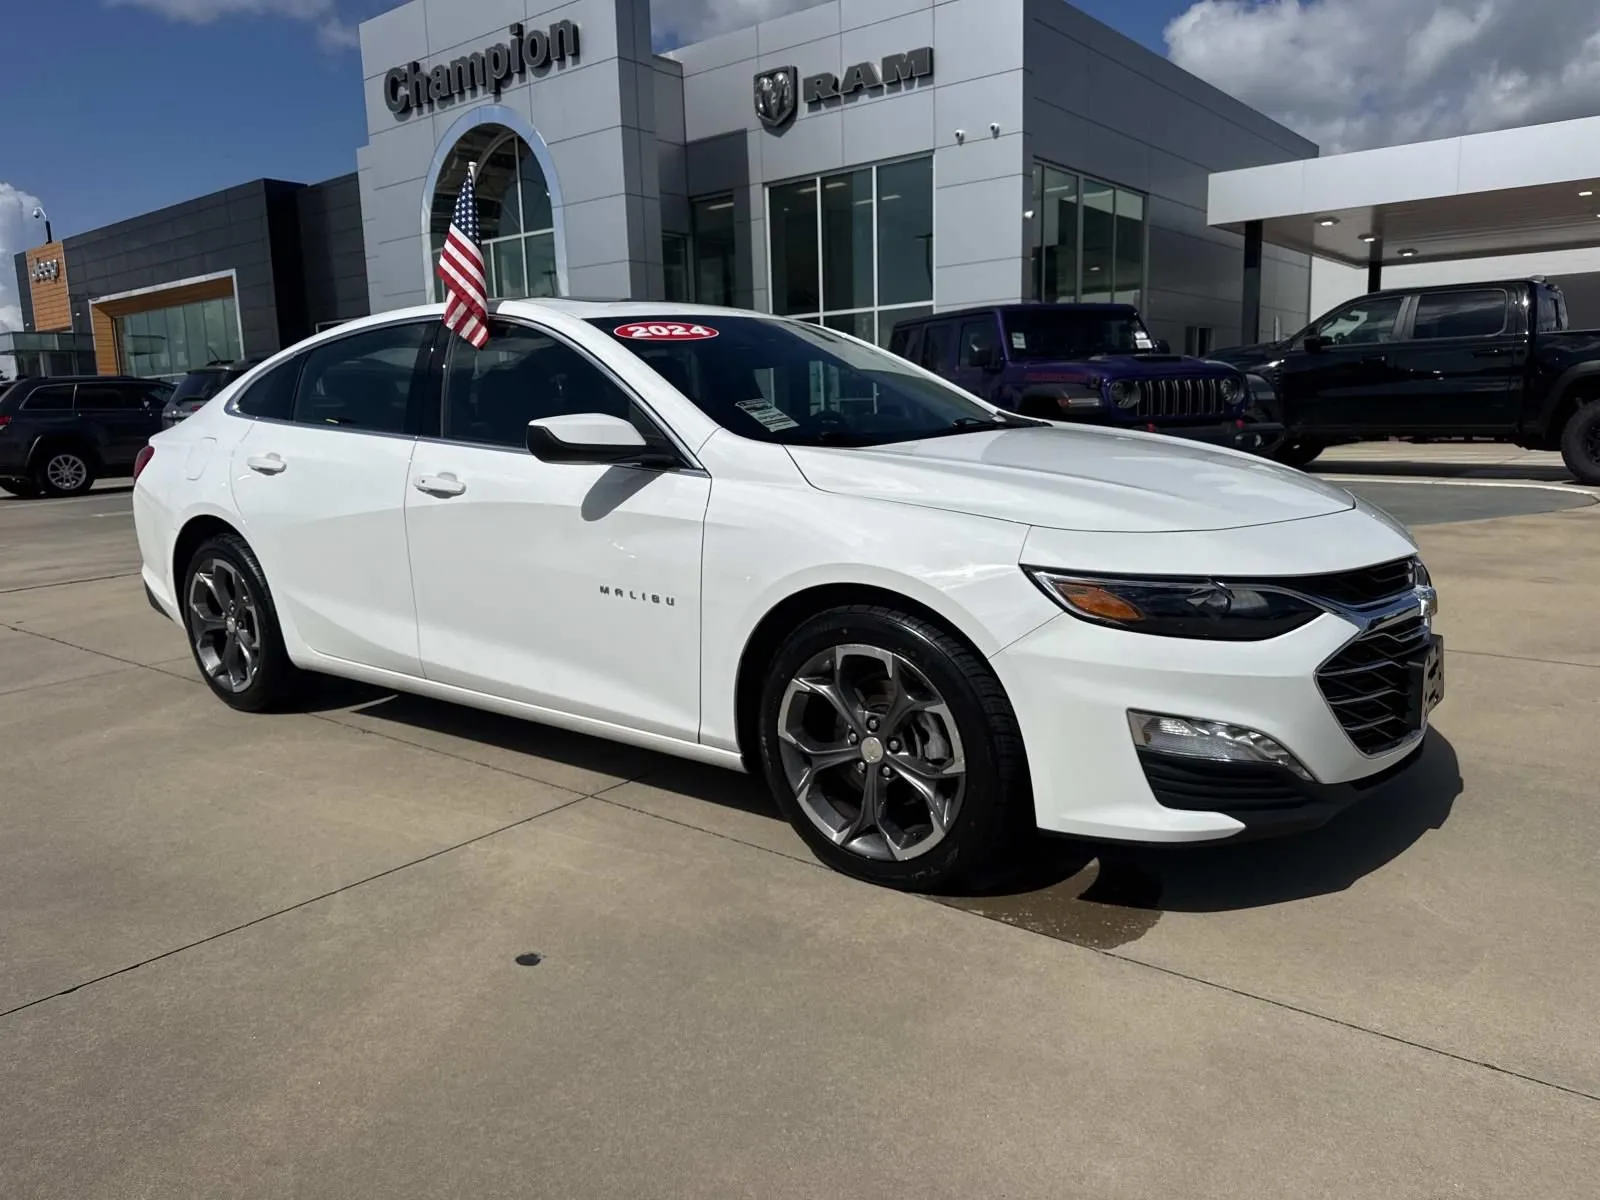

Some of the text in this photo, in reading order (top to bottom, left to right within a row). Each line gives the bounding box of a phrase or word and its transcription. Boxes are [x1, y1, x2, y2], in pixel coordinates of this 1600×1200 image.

[384, 19, 580, 113] Champion
[803, 47, 934, 103] RAM
[32, 258, 58, 281] Jeep
[627, 325, 711, 338] 2024
[600, 585, 675, 606] MALIBU
